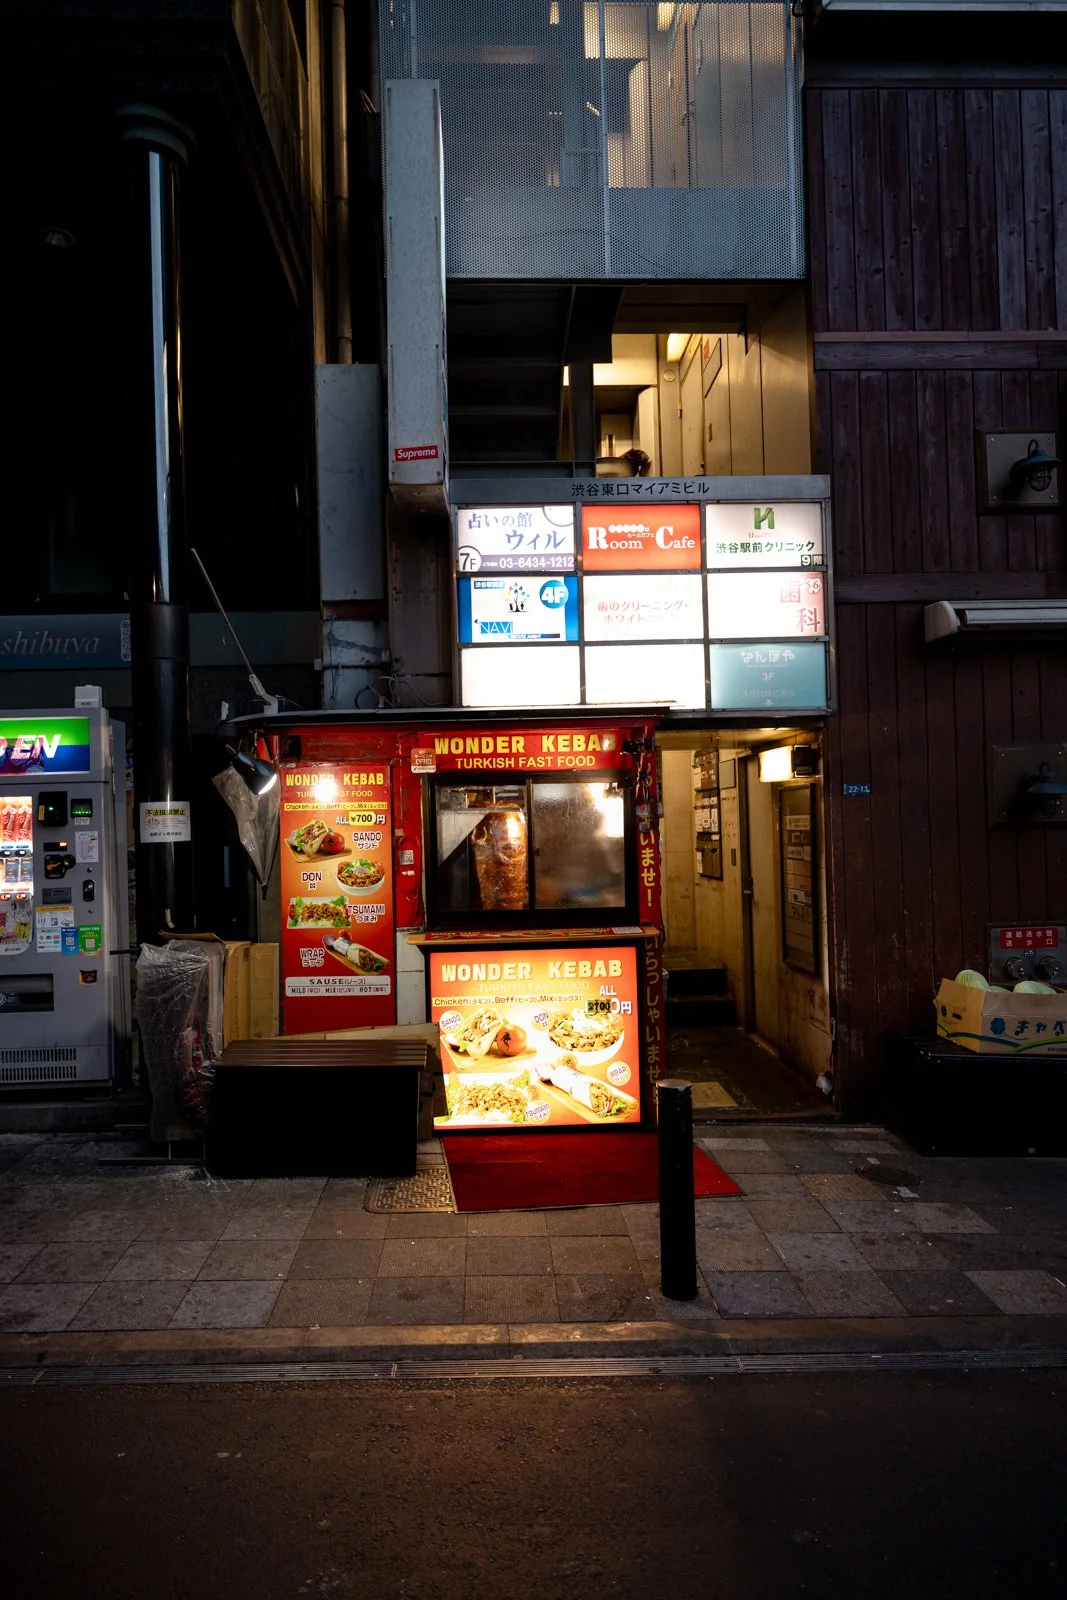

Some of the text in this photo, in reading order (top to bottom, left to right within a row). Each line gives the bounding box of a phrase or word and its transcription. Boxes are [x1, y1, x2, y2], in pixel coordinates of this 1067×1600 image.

[397, 448, 436, 460] Supreme
[571, 482, 710, 497] 渋谷東口マイアミビル
[468, 511, 533, 529] 占いの館
[505, 529, 566, 551] ウィル
[588, 525, 696, 550] Room Cafe
[716, 541, 816, 554] 渋谷駅前クリニック
[459, 552, 477, 571] 7F
[499, 556, 574, 569] 03-6434-1212
[541, 586, 567, 604] 4F
[1, 630, 100, 660] shibuya
[761, 672, 775, 681] 3F
[434, 733, 617, 755] WONDER KEBAB
[455, 755, 596, 769] TURKISH FAST FOOD
[343, 773, 384, 785] KEBAB
[335, 816, 349, 825] ALL
[351, 815, 373, 823] ¥700
[353, 832, 382, 841] SANDO
[302, 872, 322, 881] DON
[347, 905, 385, 914] TSUMAMI
[300, 948, 325, 959] WRAP
[302, 959, 324, 967] ラップ
[441, 959, 623, 982] WONDER KEBAB
[478, 980, 590, 993] TURKISH FAST FOOD
[599, 985, 617, 996] ALL
[441, 1014, 461, 1028] SANDO
[533, 1012, 549, 1023] DON
[610, 1065, 627, 1078] WRAP
